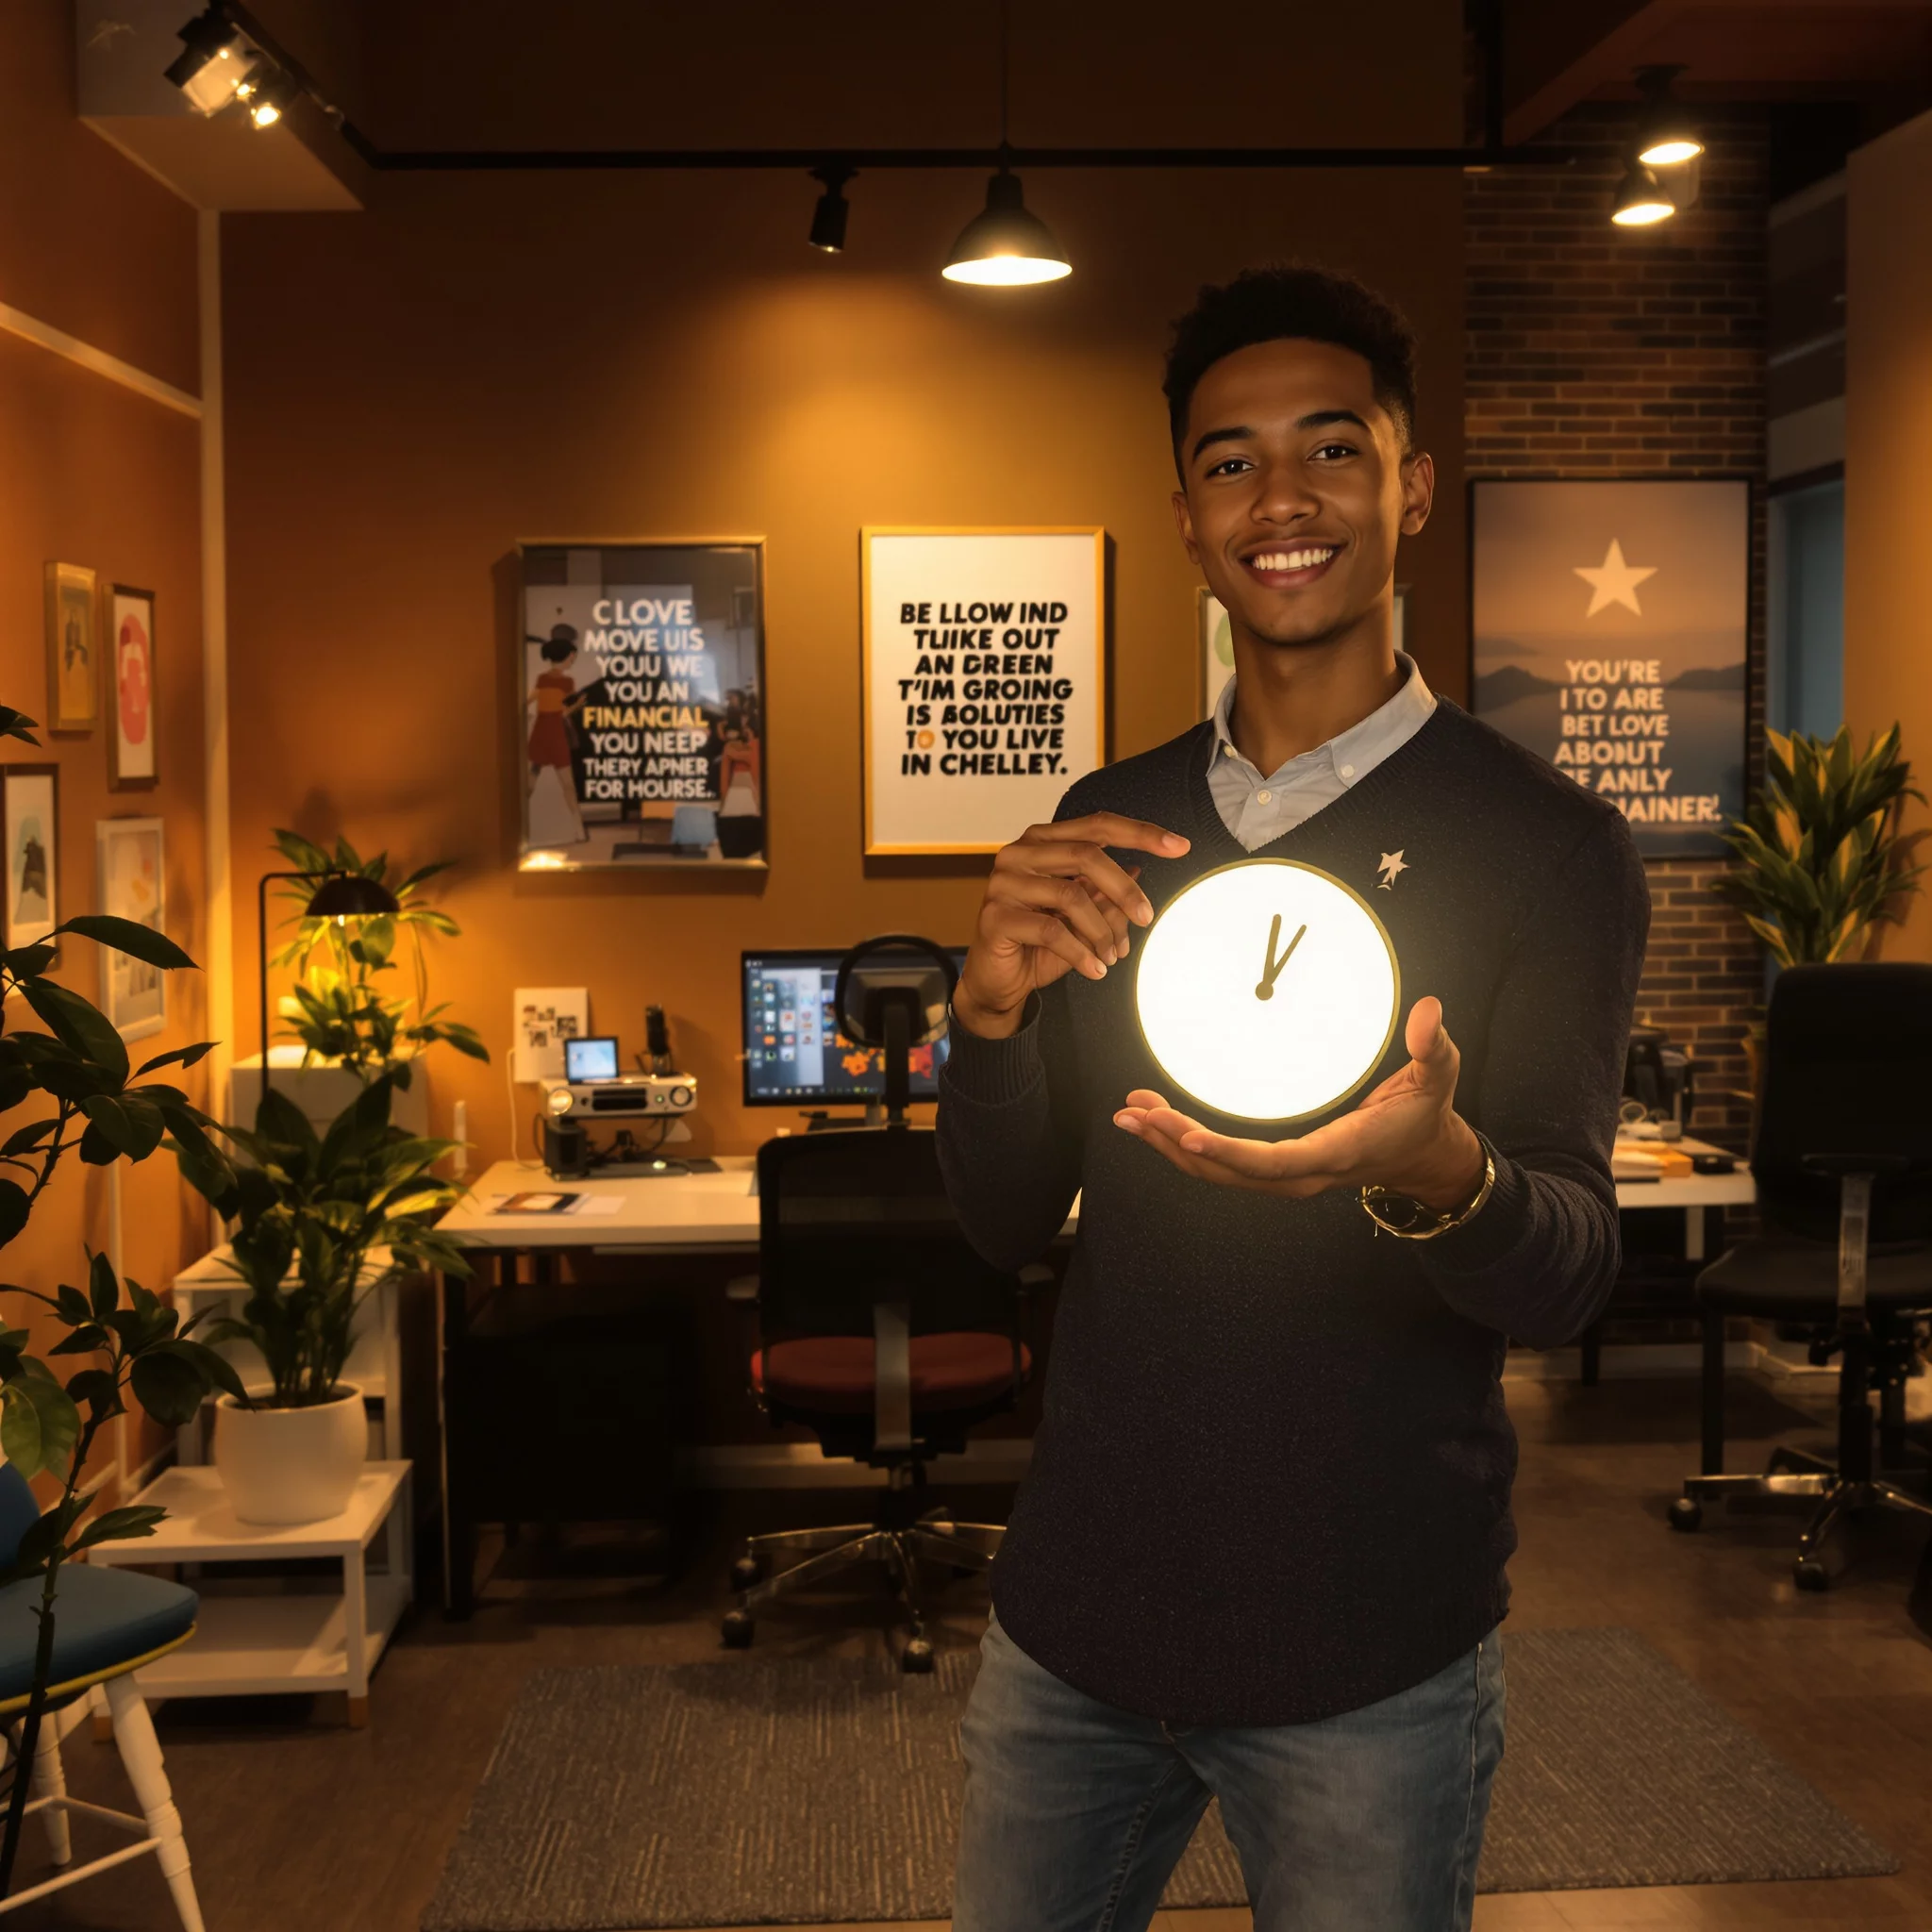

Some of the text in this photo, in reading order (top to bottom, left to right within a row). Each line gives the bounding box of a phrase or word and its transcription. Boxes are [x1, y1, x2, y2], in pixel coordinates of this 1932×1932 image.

[900, 603, 932, 624] BE
[1020, 602, 1068, 625] IND
[584, 628, 659, 653] MOVE
[1002, 628, 1060, 650] OUT
[595, 655, 703, 677] YOUU WE
[914, 655, 955, 675] AN
[1565, 659, 1660, 684] YOU'RE
[605, 680, 689, 703] YOU AN
[962, 678, 1074, 701] GROING
[1573, 688, 1607, 710] TO
[1613, 688, 1664, 710] ARE
[582, 706, 709, 728] FINANCIAL
[907, 704, 931, 725] IS
[1561, 714, 1669, 737] BET LOVE
[589, 732, 640, 755] YOU
[941, 728, 998, 750] YOU
[1007, 728, 1064, 750] LIVE
[901, 753, 1068, 776] IN CHELLEY.
[585, 779, 624, 800] FOR
[1596, 767, 1673, 793] ANLY
